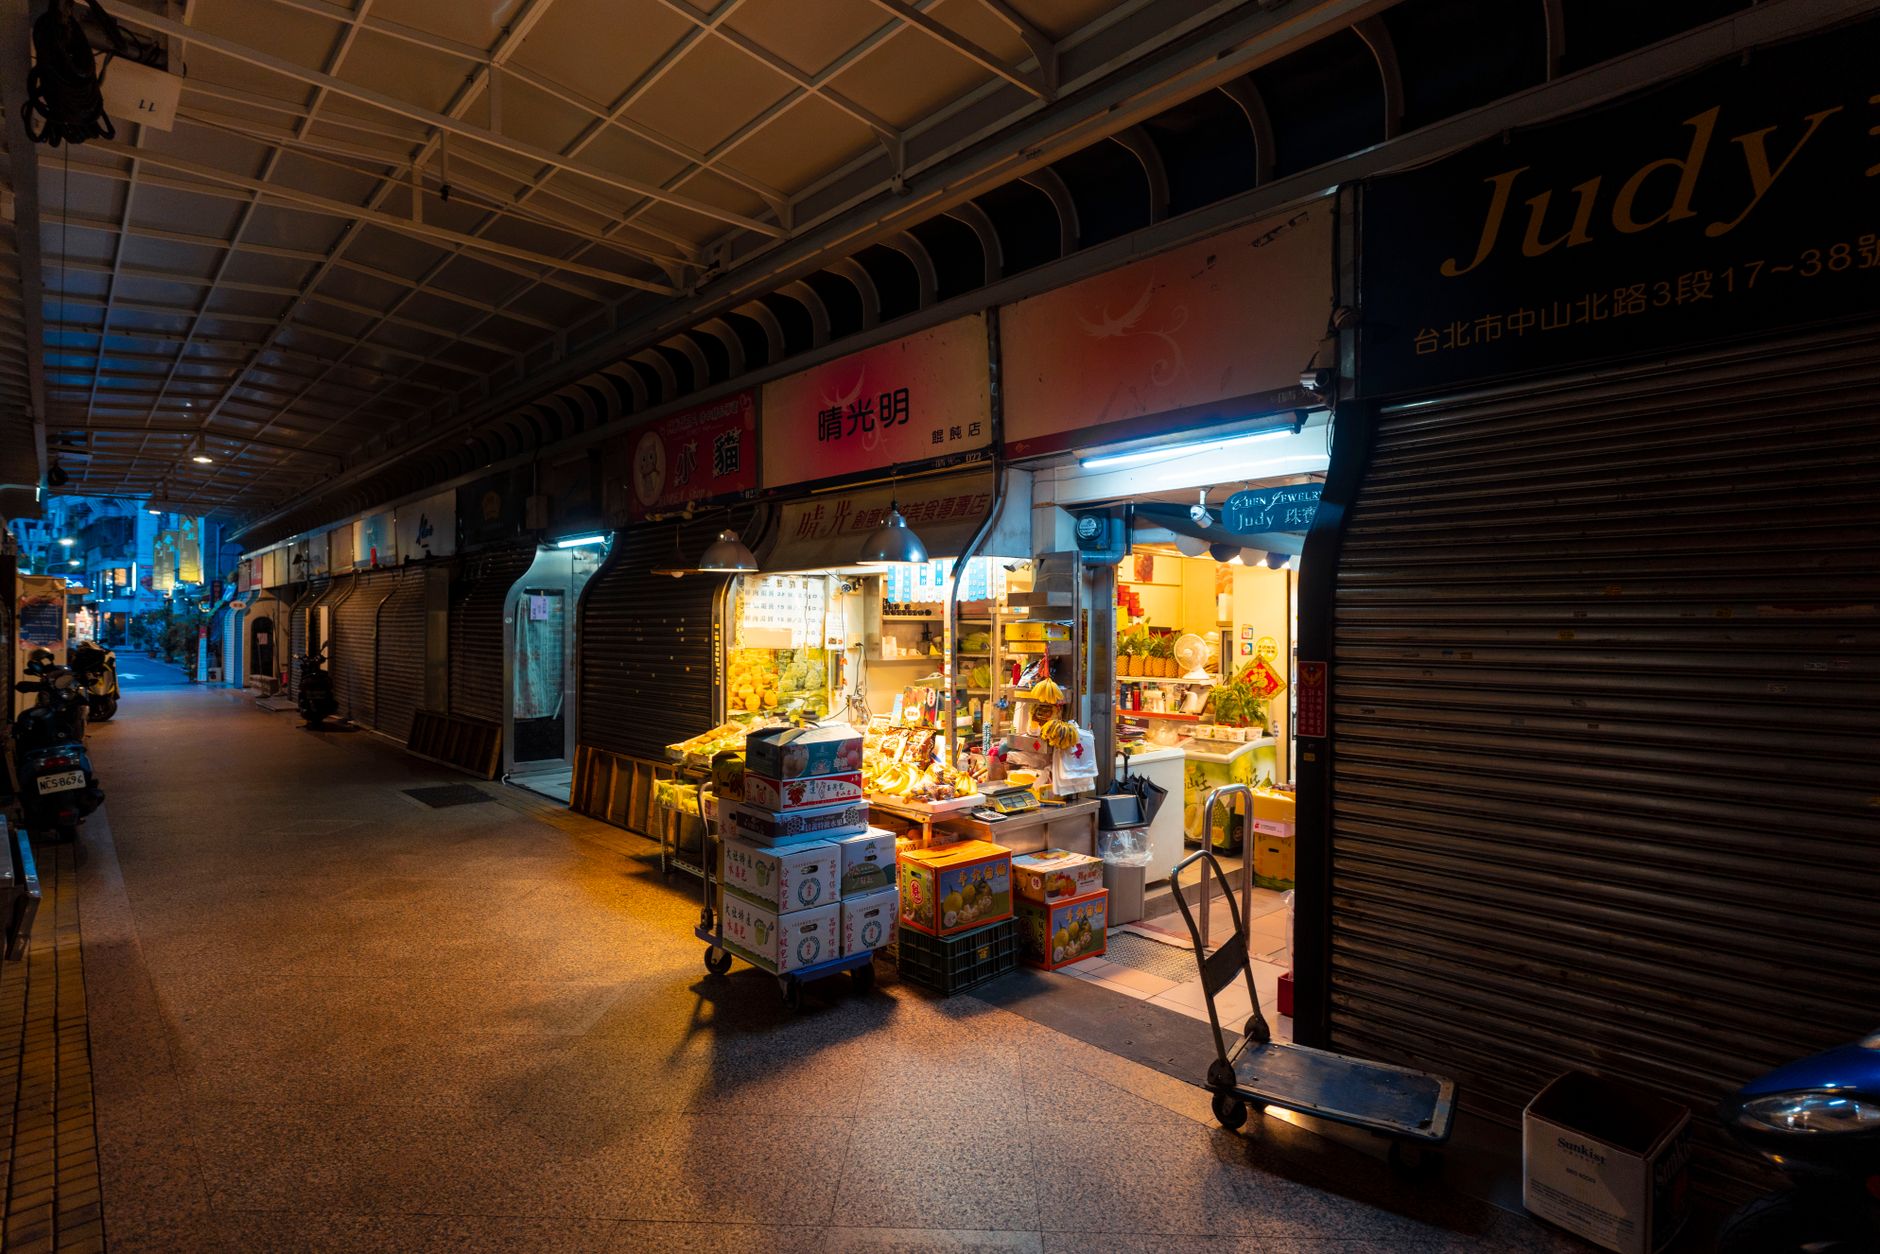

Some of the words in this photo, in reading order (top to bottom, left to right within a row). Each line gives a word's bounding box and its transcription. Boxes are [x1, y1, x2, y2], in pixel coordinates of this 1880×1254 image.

[1439, 104, 1845, 278] Judy
[818, 387, 909, 442] 晴光明
[931, 422, 982, 445] 餛飩店
[796, 500, 852, 540] 晴光
[1238, 512, 1274, 530] Judy
[1557, 1137, 1606, 1165] Sunkist
